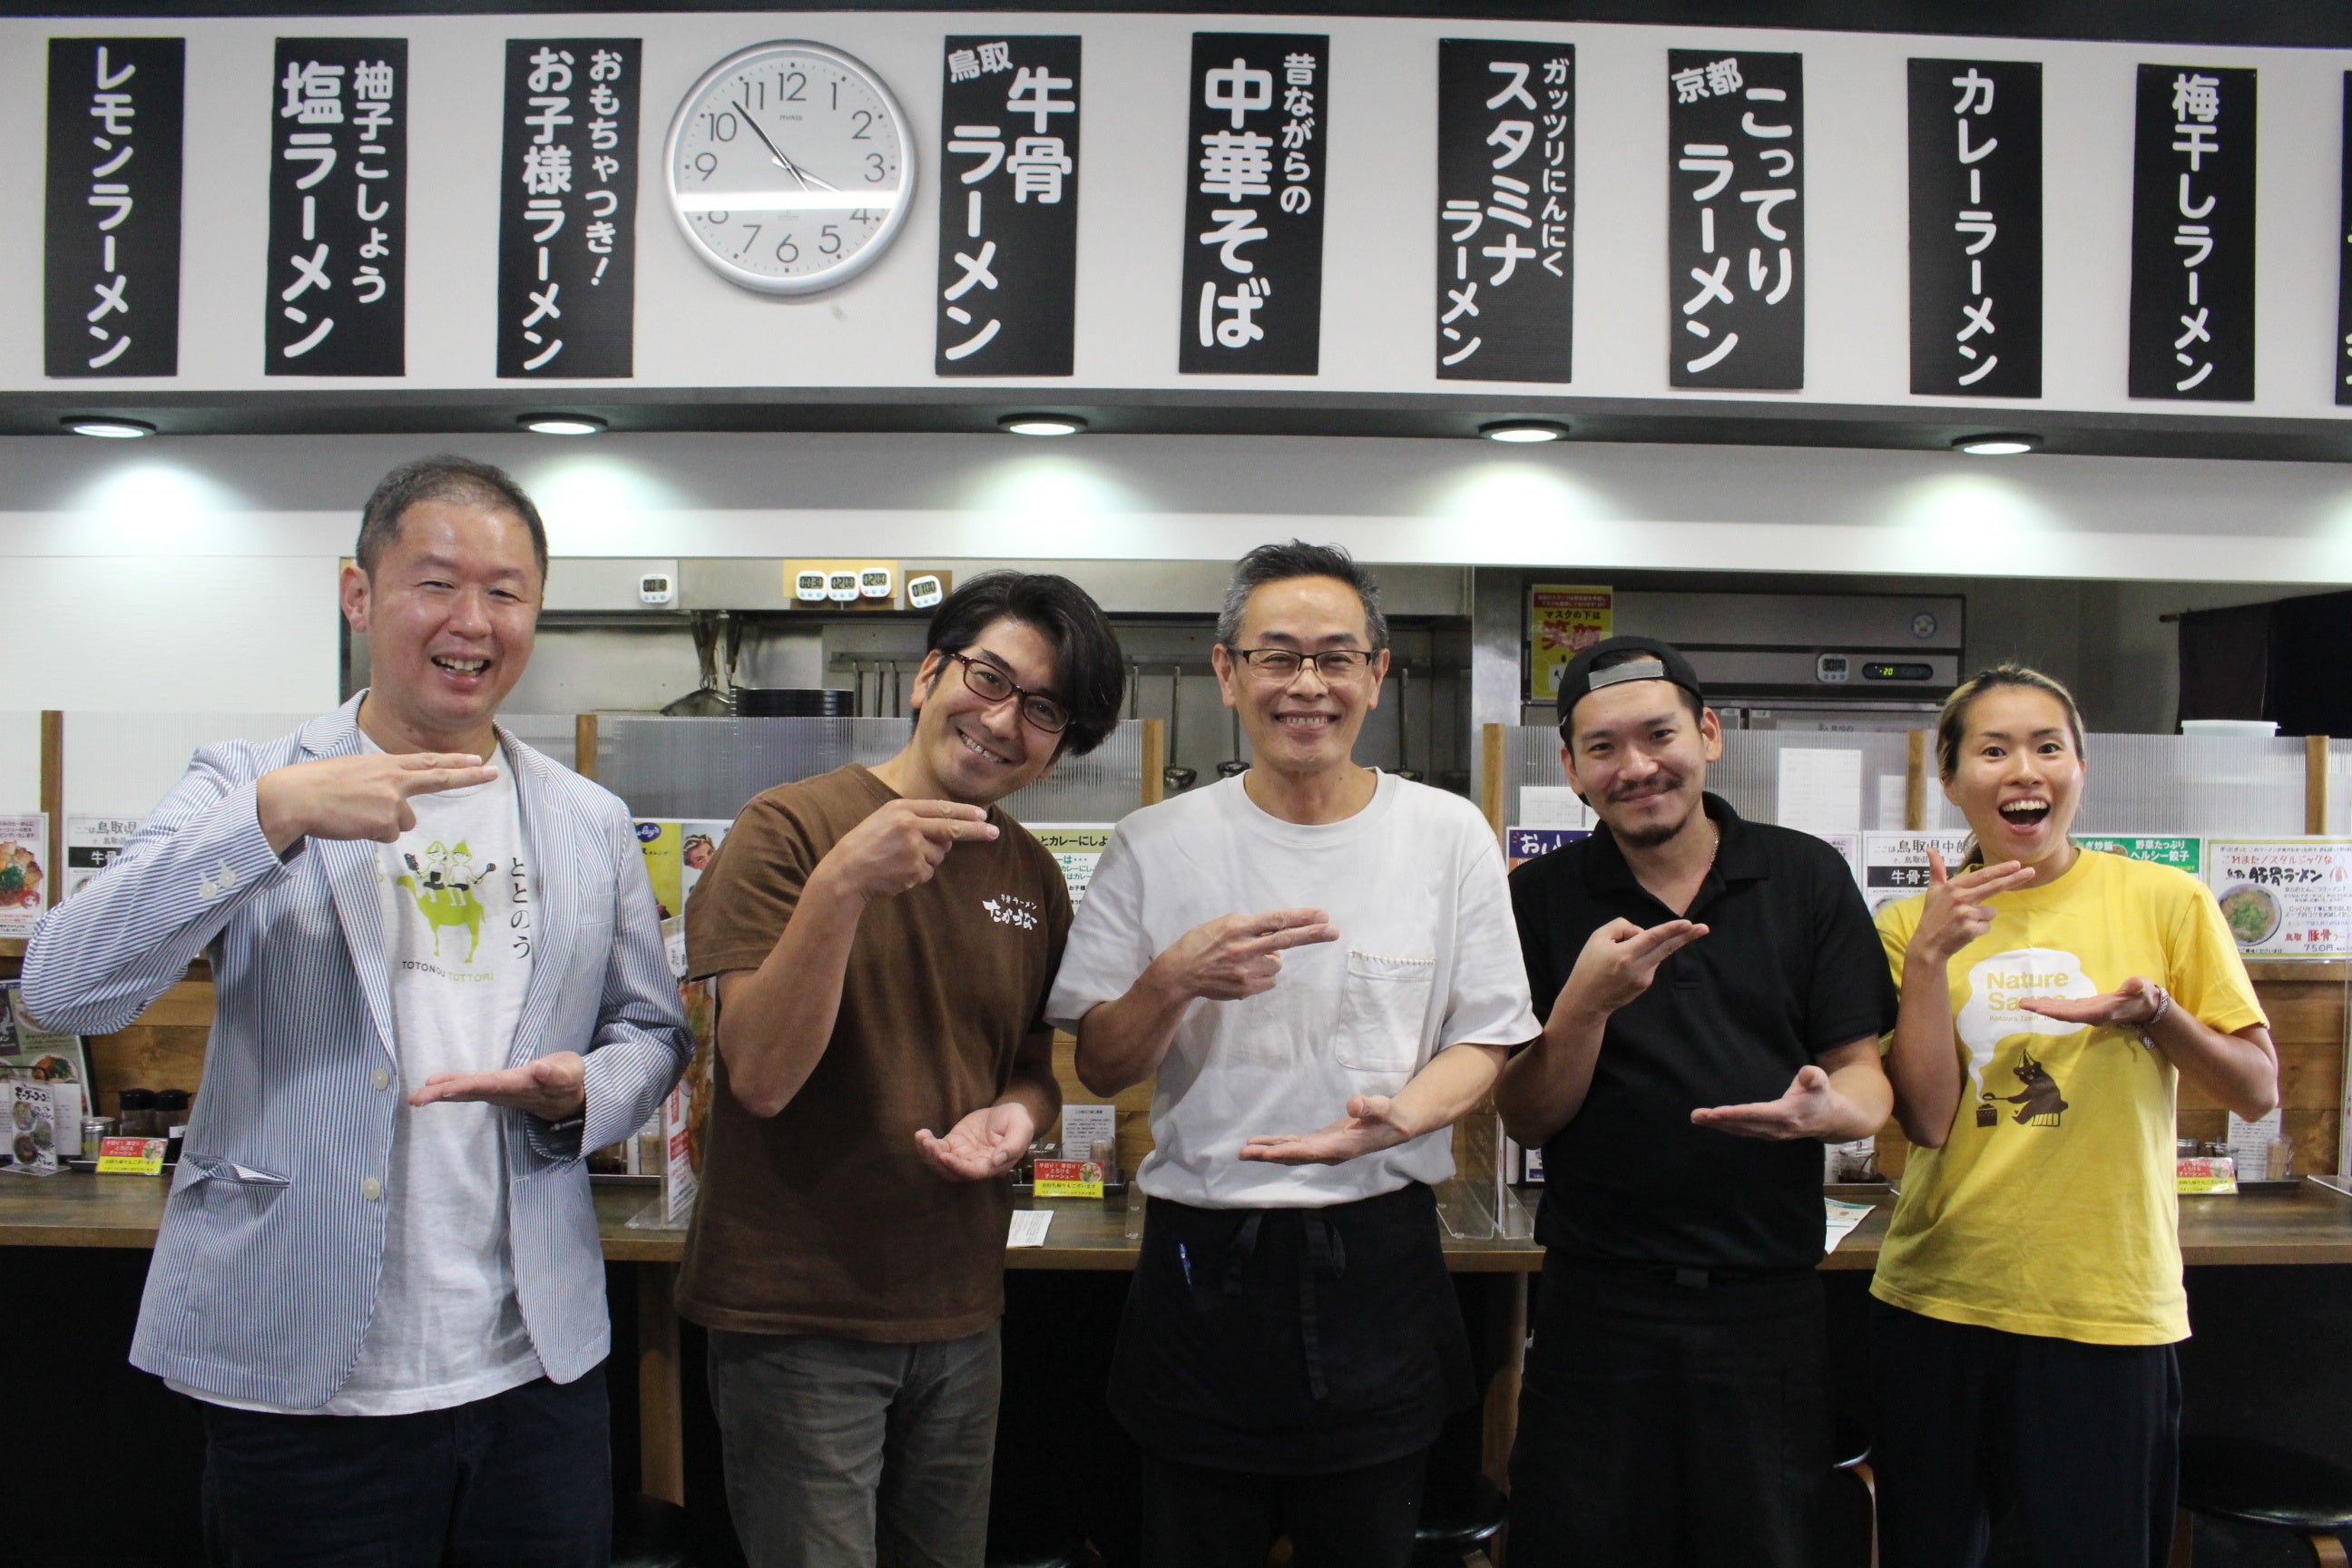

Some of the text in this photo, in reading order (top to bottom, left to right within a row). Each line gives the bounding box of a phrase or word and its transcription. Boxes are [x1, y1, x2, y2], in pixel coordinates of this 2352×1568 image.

[947, 42, 1014, 83] 鳥取
[1671, 57, 1743, 103] 京都
[744, 82, 764, 110] 11
[779, 72, 807, 101] 12
[709, 112, 737, 142] 10
[851, 110, 872, 139] 2
[1006, 66, 1075, 204] 牛骨
[1280, 53, 1317, 214] 昔ながらの
[353, 61, 394, 303] 柚子こしょう
[695, 152, 717, 181] 9
[864, 152, 885, 182] 3
[1483, 62, 1537, 287] スタミナ
[1541, 58, 1569, 277] ガッツリにんにく
[88, 46, 135, 368] レモンラーメン
[281, 61, 345, 358] 塩ラーメン
[523, 47, 574, 370] お子様ラーメン
[1199, 58, 1274, 348] 中華そば
[1740, 88, 1797, 305] こってり
[742, 224, 762, 253] 7
[776, 234, 799, 263] 6
[818, 225, 841, 254] 5
[944, 125, 1004, 360] ラーメン
[1952, 68, 1998, 386] カレーラーメン
[2172, 74, 2220, 391] 梅干しラーメン
[1679, 143, 1739, 373] ラーメン
[1441, 200, 1484, 366] ラーメン
[1544, 611, 1601, 620] マスクの下は
[1883, 667, 1894, 676] 20
[2131, 850, 2190, 861] ヘルシー餃子
[2135, 840, 2185, 850] 野菜たっぷり
[510, 857, 531, 959] ととのう
[2304, 944, 2334, 952] 750円
[448, 972, 494, 982] TOTTORI
[1987, 972, 2069, 989] Nature
